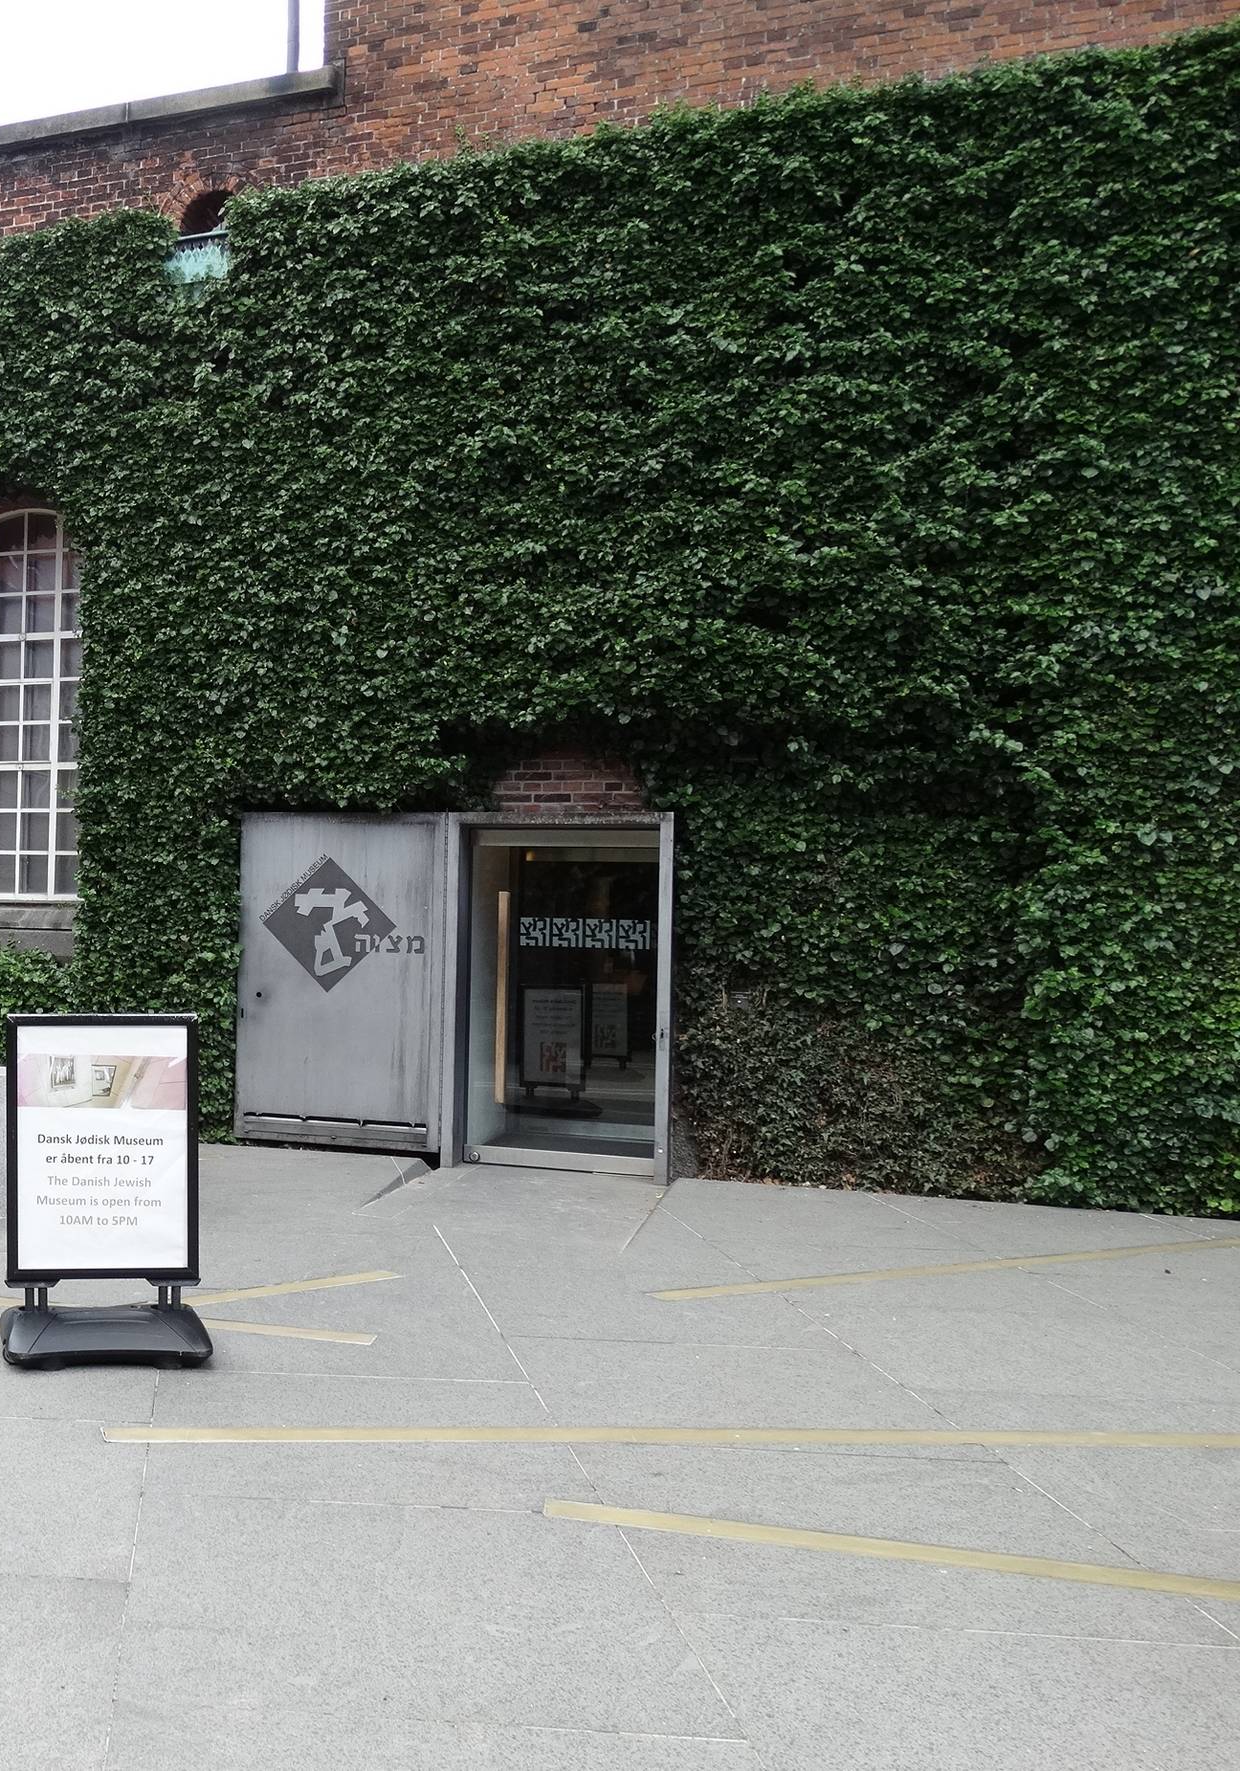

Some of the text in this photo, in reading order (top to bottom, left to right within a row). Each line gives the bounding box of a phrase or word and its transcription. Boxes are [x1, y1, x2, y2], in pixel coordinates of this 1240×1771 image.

[259, 899, 281, 922] DANSK
[300, 853, 329, 882] MUSEUM
[354, 934, 425, 955] מצוה
[37, 1133, 164, 1146] Dansk Jødisk Museum
[45, 1155, 58, 1164] er
[60, 1152, 94, 1165] åbent
[97, 1154, 113, 1165] fra
[116, 1155, 130, 1165] 10
[141, 1155, 154, 1166] 17
[47, 1176, 152, 1188] The Danish Jewish
[36, 1195, 162, 1208] Museum is open from
[59, 1215, 138, 1226] 10AM to 5PM
